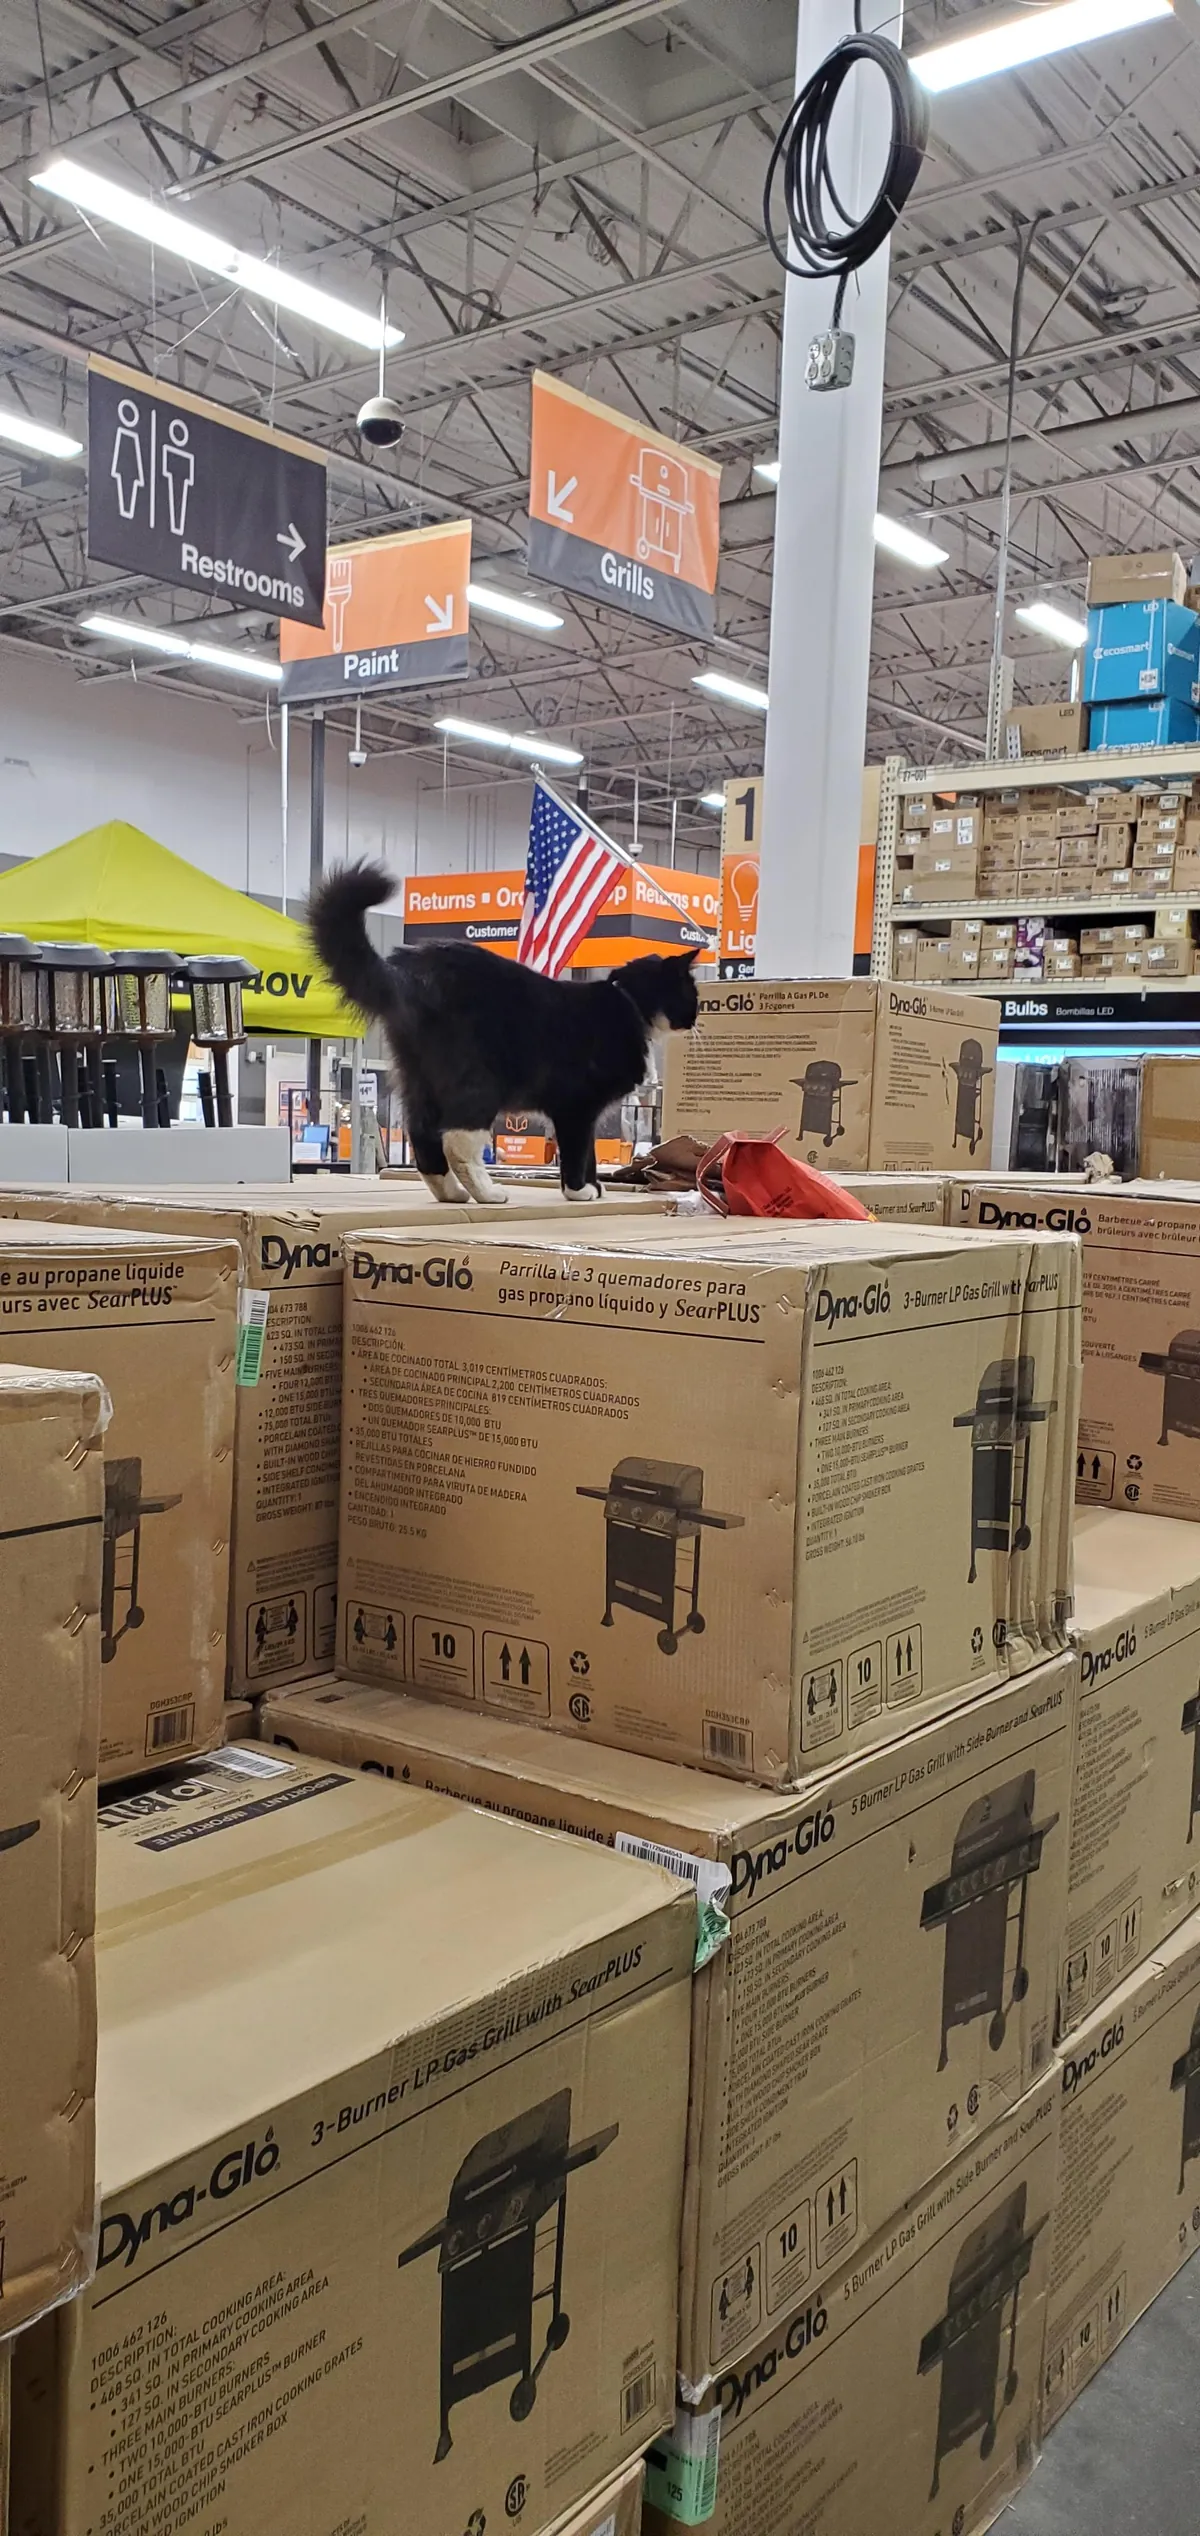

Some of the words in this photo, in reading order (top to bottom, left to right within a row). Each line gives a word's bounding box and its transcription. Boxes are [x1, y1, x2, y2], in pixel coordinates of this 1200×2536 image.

[181, 543, 305, 608] Restrooms
[601, 552, 654, 600] Grills
[1143, 604, 1159, 612] LED
[344, 650, 399, 681] Paint
[1103, 641, 1150, 657] ecosmart
[1059, 708, 1075, 717] LED
[735, 788, 754, 841] 1
[409, 891, 476, 912] Returns
[636, 881, 689, 909] Returns
[703, 895, 720, 915] Or
[466, 925, 518, 938] Customer
[240, 970, 313, 998] 40V
[700, 993, 754, 1012] na-Glo
[759, 992, 785, 1000] Parrilla
[787, 992, 793, 1000] A
[794, 992, 807, 1000] Gas
[765, 1003, 795, 1011] Fogones
[889, 993, 927, 1016] Dyna-Glo
[1005, 1001, 1049, 1016] Bulbs
[1056, 1007, 1095, 1016] Bombillas
[1097, 1007, 1114, 1015] LED
[874, 1204, 895, 1215] Burner
[895, 1203, 907, 1214] and
[979, 1202, 1091, 1235] Dyna-Glo
[1098, 1214, 1140, 1227] Barbecue
[1157, 1218, 1195, 1232] propane
[1097, 1226, 1136, 1238] brûleurs
[1138, 1230, 1159, 1240] avec
[1161, 1229, 1196, 1243] brûleur
[17, 1272, 39, 1285] au
[44, 1267, 120, 1289] propane
[125, 1262, 185, 1284] liquide
[353, 1250, 473, 1292] Dyna-Glo
[500, 1260, 556, 1279] Parrilla
[561, 1266, 581, 1281] de
[583, 1267, 594, 1282] 3
[598, 1268, 702, 1292] quemadores
[706, 1279, 746, 1297] para
[38, 1297, 80, 1311] avec
[87, 1286, 173, 1311] SearPLUS
[498, 1288, 526, 1304] gas
[530, 1290, 594, 1308] propano
[598, 1294, 654, 1317] líquido
[659, 1302, 669, 1318] y
[674, 1298, 761, 1324] SearPLUS
[815, 1283, 891, 1330] Dyna-Glo
[904, 1291, 947, 1310] 3-Burner
[949, 1286, 961, 1303] LP
[963, 1284, 979, 1301] Gas
[981, 1280, 1000, 1298] Grill
[1002, 1279, 1022, 1296] wth
[370, 1377, 419, 1392] SECUNDARIA
[456, 1388, 488, 1401] COCINA
[492, 1393, 506, 1403] 819
[508, 1395, 571, 1412] CENTÍMETROS
[572, 1403, 629, 1420] CUADRADOS
[431, 1631, 456, 1659] 10
[1081, 1630, 1137, 1686] Dyna-Glo
[858, 1657, 871, 1686] 10
[850, 1797, 858, 1817] 5
[860, 1778, 893, 1811] Burner
[896, 1770, 908, 1792] LP
[910, 1761, 926, 1785] Gas
[928, 1751, 944, 1775] Grill
[948, 1739, 966, 1765] with
[967, 1730, 984, 1754] Side
[986, 1715, 1011, 1744] Burner
[1012, 1707, 1028, 1730] and
[1028, 1688, 1062, 1721] SearPLUS
[264, 1777, 338, 1808] IMPORTANT
[152, 1810, 248, 1846] IMPORTANTE
[559, 1818, 604, 1844] liquide
[606, 1832, 614, 1847] à
[731, 1812, 835, 1898] Dyna-Glo
[1101, 1934, 1111, 1959] 10
[311, 2074, 406, 2147] 3-Burner
[413, 2057, 438, 2091] LP
[441, 2035, 478, 2075] Gas
[481, 2011, 521, 2053] Grill
[526, 1989, 560, 2029] with
[570, 1943, 642, 2004] SearPLUS
[1062, 2022, 1124, 2094] Dyna-Glo
[96, 2140, 278, 2272] Dyna-Glo
[844, 2278, 850, 2302] 5
[852, 2245, 886, 2294] Burner
[887, 2233, 899, 2262] LP
[900, 2218, 916, 2250] Gas
[918, 2199, 937, 2235] Grill
[938, 2181, 957, 2215] with
[958, 2166, 974, 2198] Side
[976, 2141, 1001, 2181] Burner
[1002, 2126, 1018, 2157] and
[1020, 2095, 1052, 2141] SearPLUS
[780, 2222, 798, 2258] 10
[92, 2340, 120, 2372] 1006
[122, 2325, 144, 2352] 462
[148, 2309, 168, 2335] 126
[101, 2381, 122, 2409] 468
[126, 2366, 144, 2392] SQ.
[148, 2355, 160, 2376] IN
[164, 2328, 199, 2366] TOTAL
[203, 2292, 252, 2338] COOKING
[254, 2268, 286, 2303] AREA:
[1080, 2322, 1091, 2348] 10
[90, 2322, 176, 2395] DESCRIPTION:
[122, 2406, 142, 2434] 127
[145, 2391, 162, 2417] SQ.
[168, 2380, 179, 2401] IN
[182, 2330, 249, 2391] SECONDARY
[251, 2295, 299, 2342] COOKING
[301, 2274, 328, 2306] AREA
[715, 2308, 828, 2417] Dyna-Glo
[104, 2426, 142, 2467] THREE
[145, 2401, 176, 2437] MAIN
[179, 2358, 235, 2412] BURNERS:
[168, 2449, 214, 2498] COATED
[217, 2424, 246, 2460] CAST
[248, 2404, 272, 2436] IRON
[275, 2366, 322, 2415] COOKING
[324, 2334, 363, 2377] GRATES
[152, 2486, 188, 2527] WOOD
[191, 2463, 218, 2497] CHIP
[220, 2428, 264, 2475] SMOKER
[266, 2410, 288, 2440] BOX
[174, 2479, 226, 2530] IGNITION
[667, 2481, 683, 2502] 125
